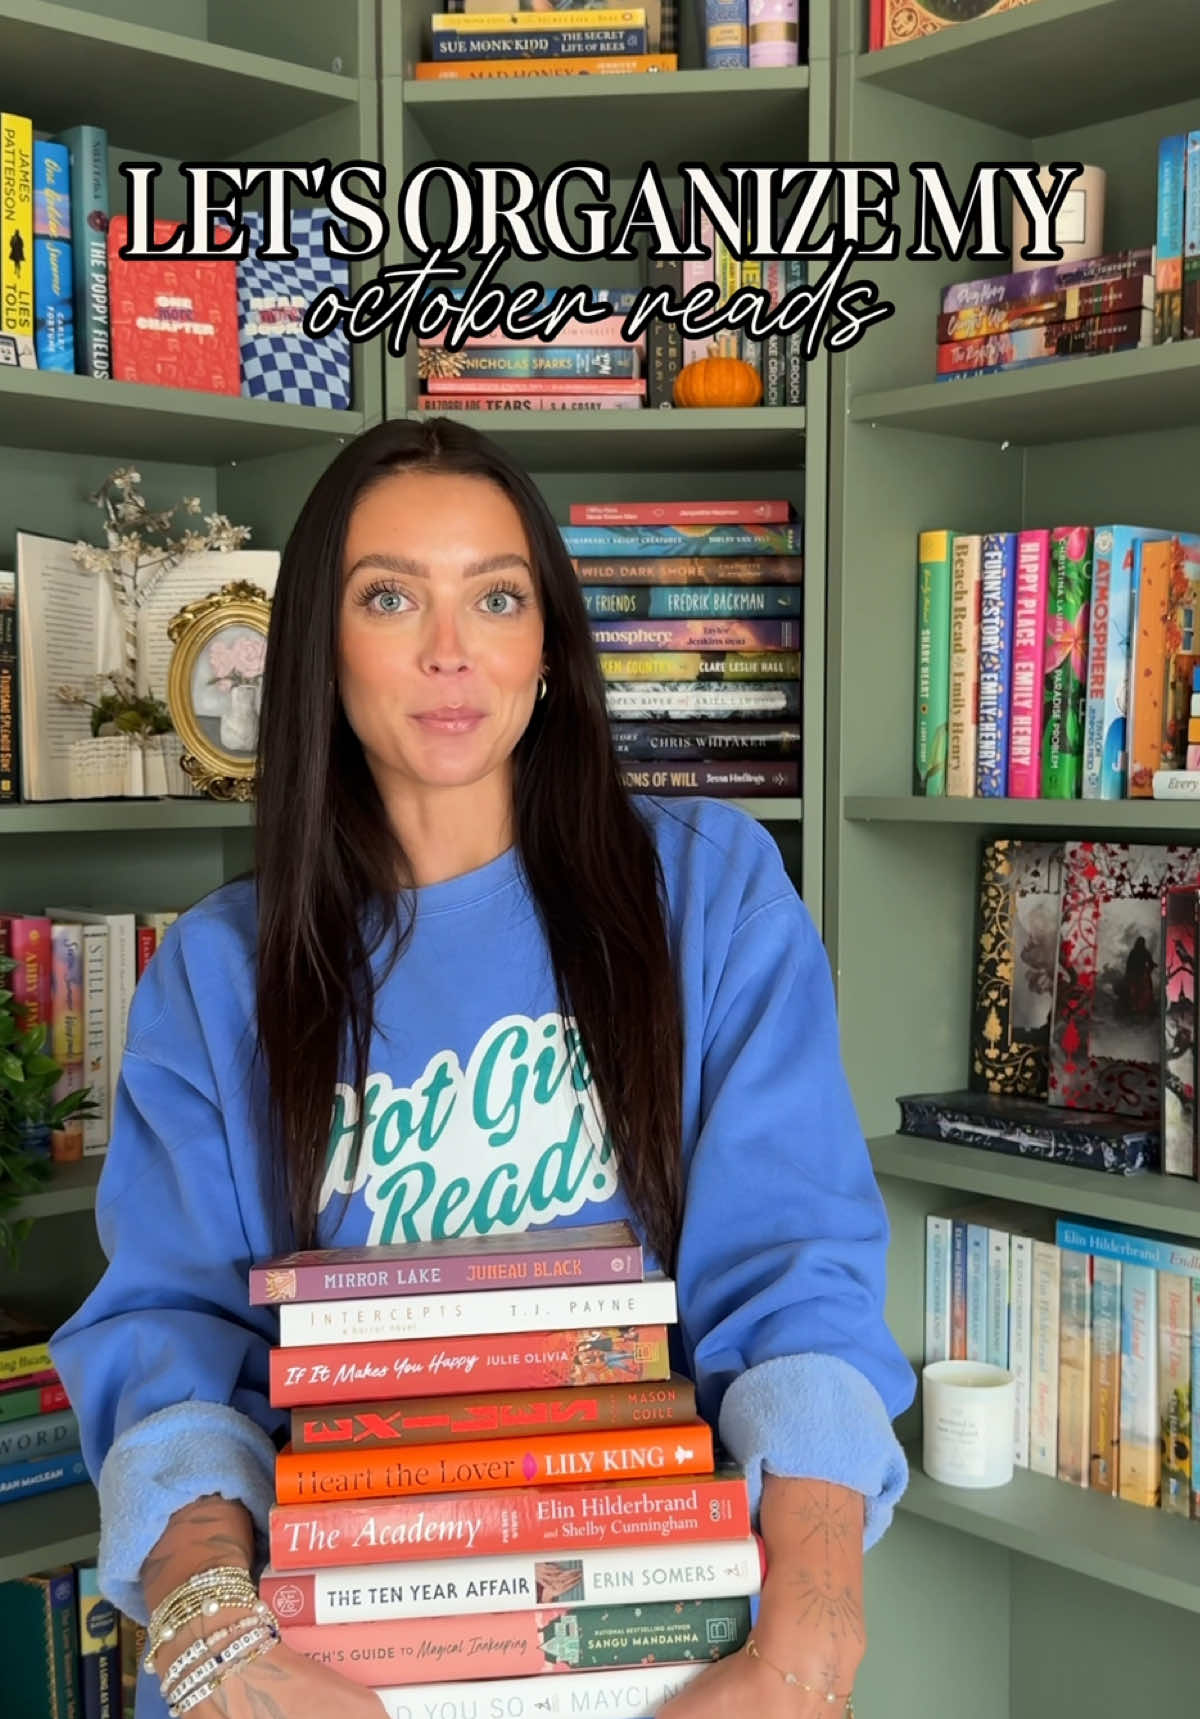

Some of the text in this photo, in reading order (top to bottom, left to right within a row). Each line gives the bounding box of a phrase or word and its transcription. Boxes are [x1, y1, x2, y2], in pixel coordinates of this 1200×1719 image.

[440, 38, 548, 53] SUE MONK KIDD
[561, 43, 584, 52] LIFE
[600, 42, 624, 51] BEES
[562, 32, 624, 41] THE SECRET
[5, 129, 16, 221] PATTERSON
[19, 150, 29, 203] JAMES
[45, 158, 62, 296] One Golden Summer
[6, 284, 17, 329] TOLD
[19, 291, 30, 328] LIES
[91, 242, 109, 379] THE POPPY FIELDS
[47, 306, 55, 353] FORTUNE
[136, 317, 214, 335] CHAPTER
[466, 359, 529, 369] NICHOLAS
[532, 359, 573, 369] SPARKS
[768, 360, 778, 406] CROUCH
[790, 357, 800, 404] CROUCH
[486, 400, 531, 410] TEARS
[582, 567, 614, 577] WILD
[620, 566, 654, 577] DARK
[662, 565, 705, 577] SHORE
[1056, 538, 1066, 596] CHRISTINA
[596, 595, 637, 612] FRIENDS
[668, 593, 765, 611] FREDRIK BACKMAN
[953, 544, 969, 654] Beach Read
[982, 552, 1002, 654] FUNNY STORY
[1015, 542, 1040, 647] HAPPY PLACE
[593, 628, 673, 645] mosphere
[1090, 559, 1111, 700] ATMOSPHERE
[699, 662, 783, 673] CLARE LESLIE HALL
[919, 629, 931, 698] SHARK HEART
[1, 675, 12, 714] THOUSAND
[949, 672, 966, 771] Emily Henry
[979, 672, 998, 769] EMILY HENRY
[1012, 662, 1035, 767] EMILY HENRY
[1050, 669, 1062, 769] PARADISE PROBLEM
[650, 736, 767, 749] CHRIS WHITAKER
[651, 772, 667, 788] OF
[670, 772, 699, 788] WILL
[88, 945, 105, 1050] STILL LIFE
[325, 1062, 457, 1183] Hot
[1064, 1230, 1160, 1260] Elin Hilderbrand
[324, 1268, 441, 1289] MIRROR LAKE
[466, 1259, 583, 1281] JUNEAU BLACK
[311, 1304, 464, 1328] INTERCEPTS
[569, 1298, 636, 1313] PAYNE
[284, 1352, 479, 1387] If It Makes You Happy
[487, 1351, 569, 1366] JULIE OLIVIA
[628, 1391, 675, 1404] MASON
[303, 1398, 598, 1444] EXILES
[632, 1407, 673, 1421] COILE
[298, 1457, 514, 1495] Heart the Lover
[545, 1447, 665, 1476] LILY KING
[537, 1490, 698, 1520] Elin Hilderbrand
[285, 1511, 481, 1553] The Academy
[561, 1522, 606, 1540] Shelby
[610, 1518, 698, 1536] Cunningham
[327, 1577, 530, 1607] THE TEN YEAR AFFAIR
[592, 1565, 716, 1590] ERIN SOMERS
[350, 1636, 528, 1661] GUIDE TO Magical Innkeeping
[587, 1633, 699, 1649] SANGU MANDANNA
[424, 1698, 478, 1719] YOU
[489, 1696, 524, 1719] SO
[571, 1686, 649, 1713] MAYCI
